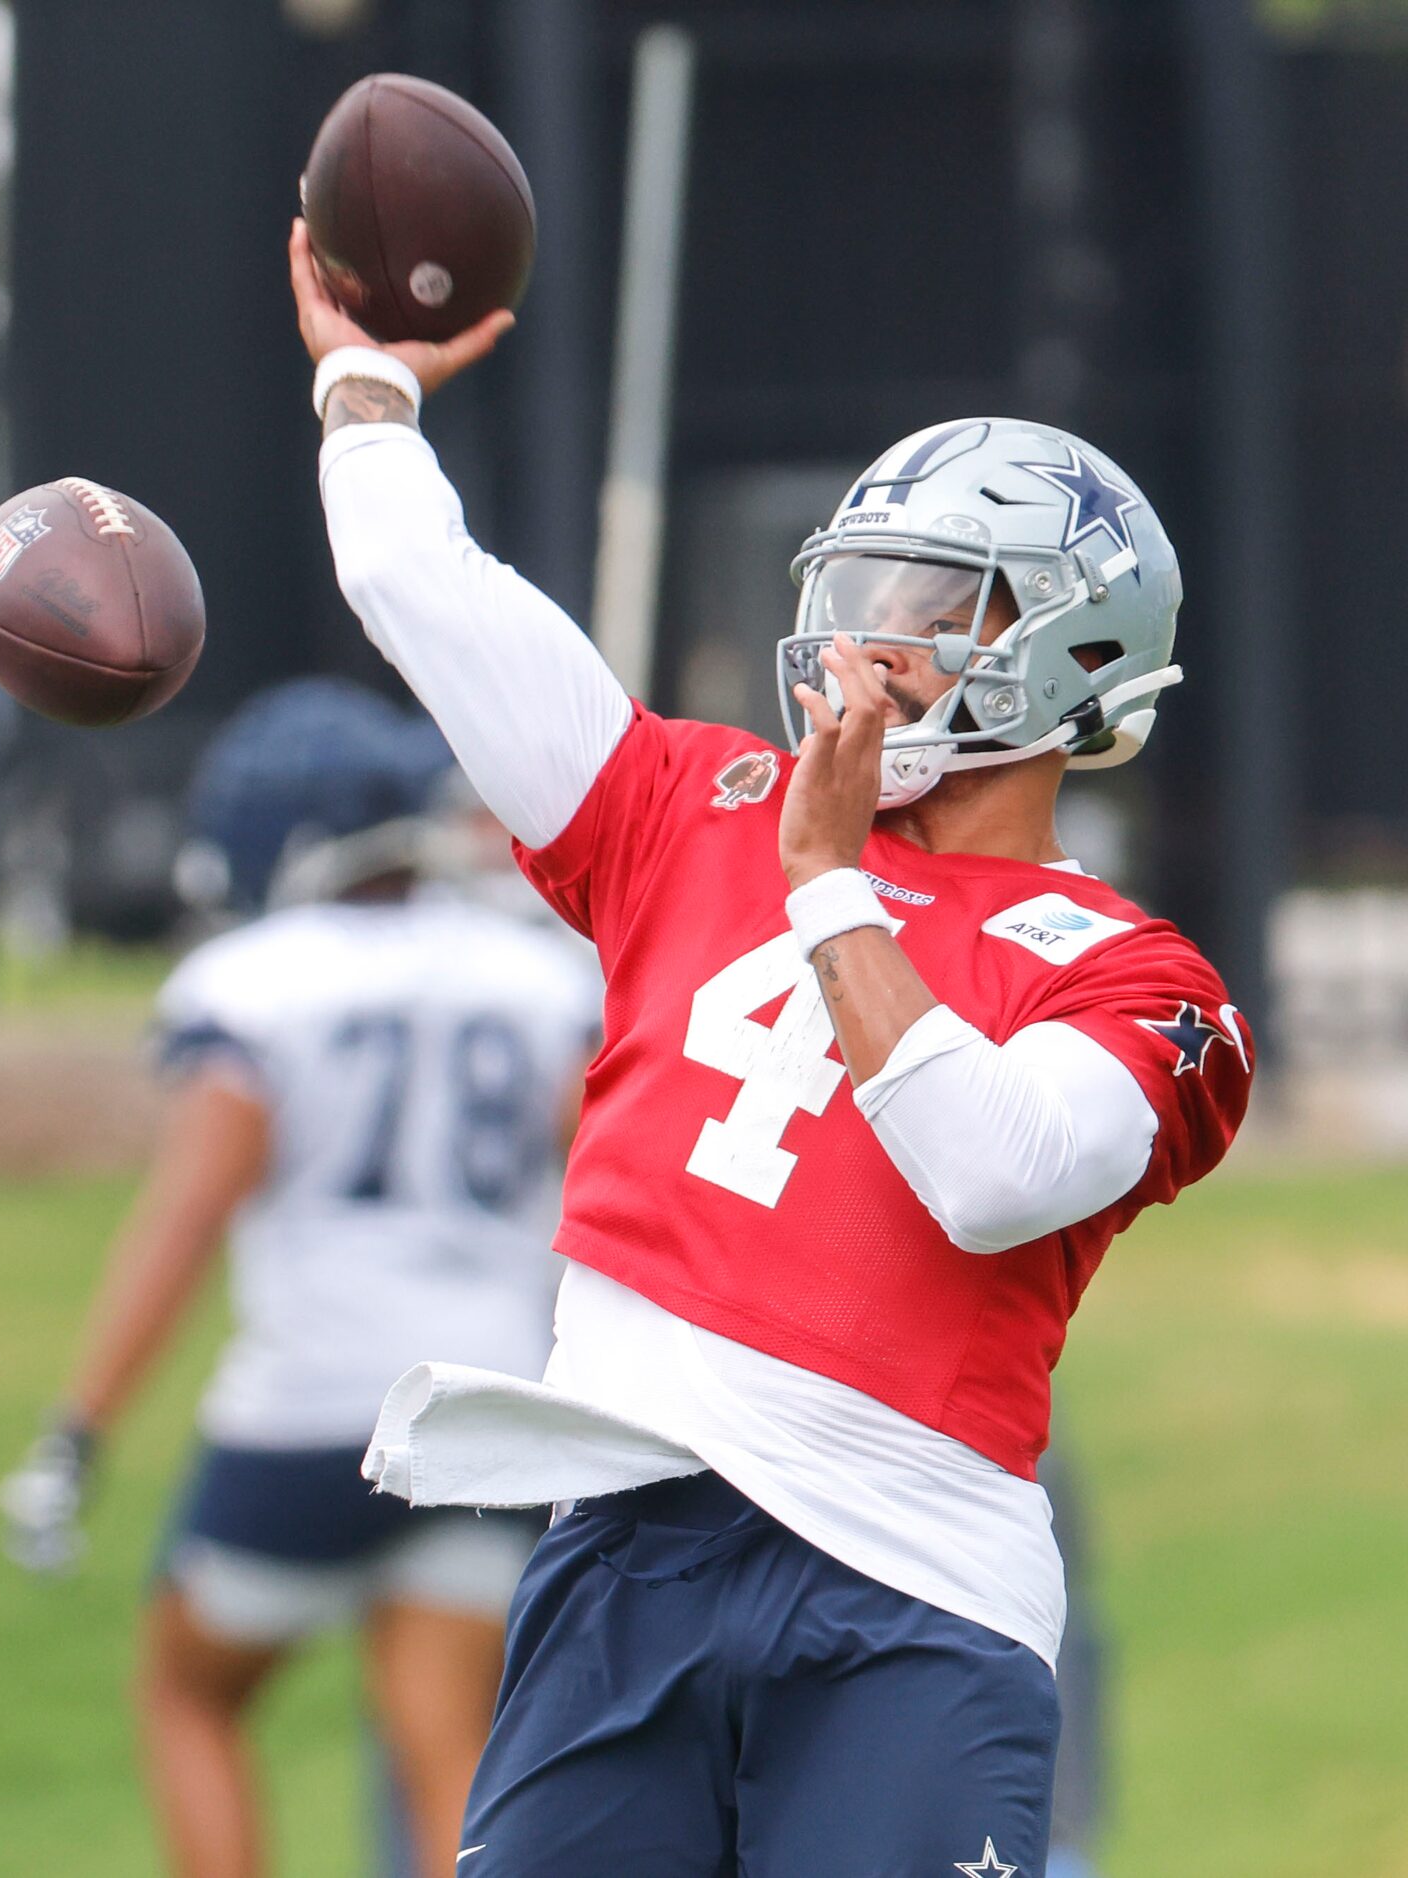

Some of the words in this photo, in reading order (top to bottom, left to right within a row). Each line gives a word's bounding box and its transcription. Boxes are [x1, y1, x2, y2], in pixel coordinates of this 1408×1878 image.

[838, 511, 891, 529] COWBOYS
[1006, 923, 1065, 946] AT&T
[325, 1008, 554, 1213] 78
[683, 917, 906, 1210] 4
